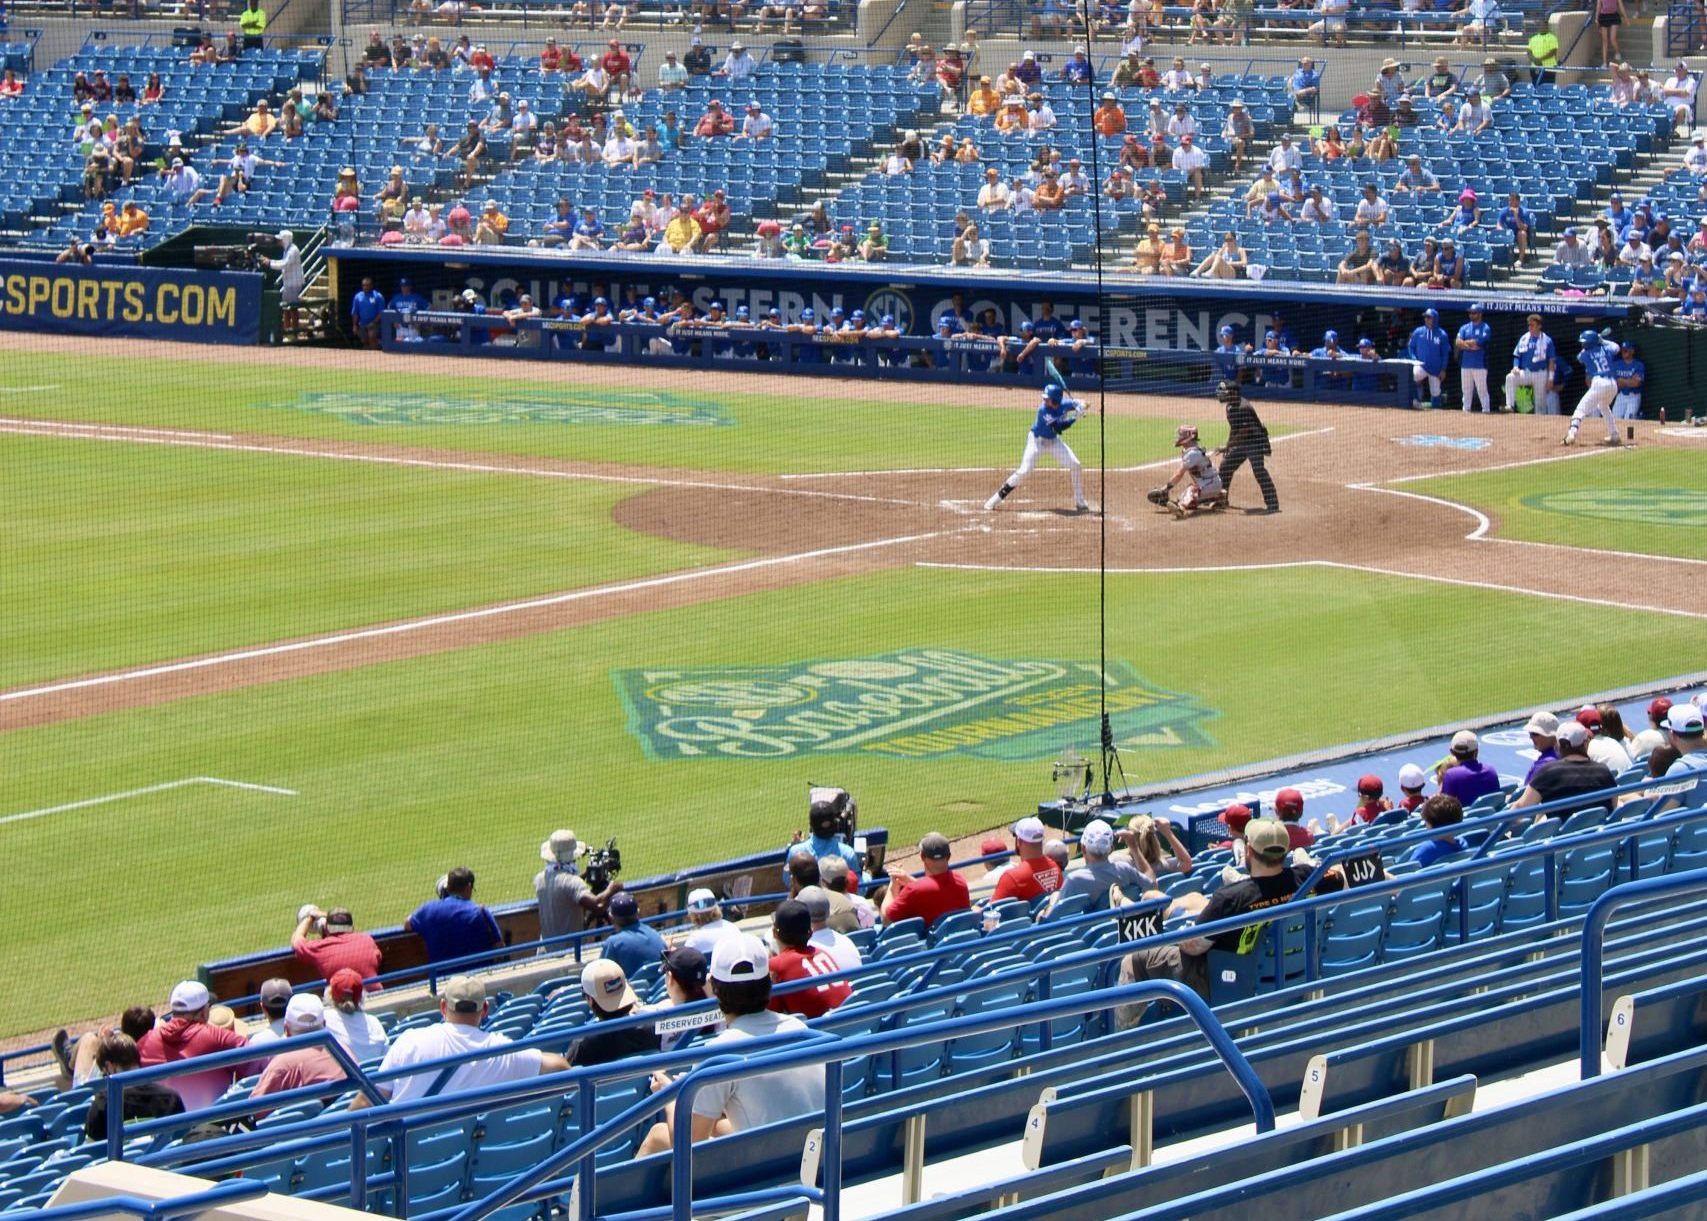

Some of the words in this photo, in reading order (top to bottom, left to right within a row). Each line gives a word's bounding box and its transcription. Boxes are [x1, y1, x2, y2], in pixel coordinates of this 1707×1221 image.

[0, 274, 236, 327] SPORTS.COM
[1495, 303, 1512, 311] JUST
[1515, 303, 1542, 312] MEANS
[660, 1017, 702, 1031] RESERVED
[1617, 1012, 1625, 1025] 6
[1311, 1070, 1319, 1082] 5
[1031, 1117, 1038, 1129] 4
[809, 1141, 816, 1152] 2
